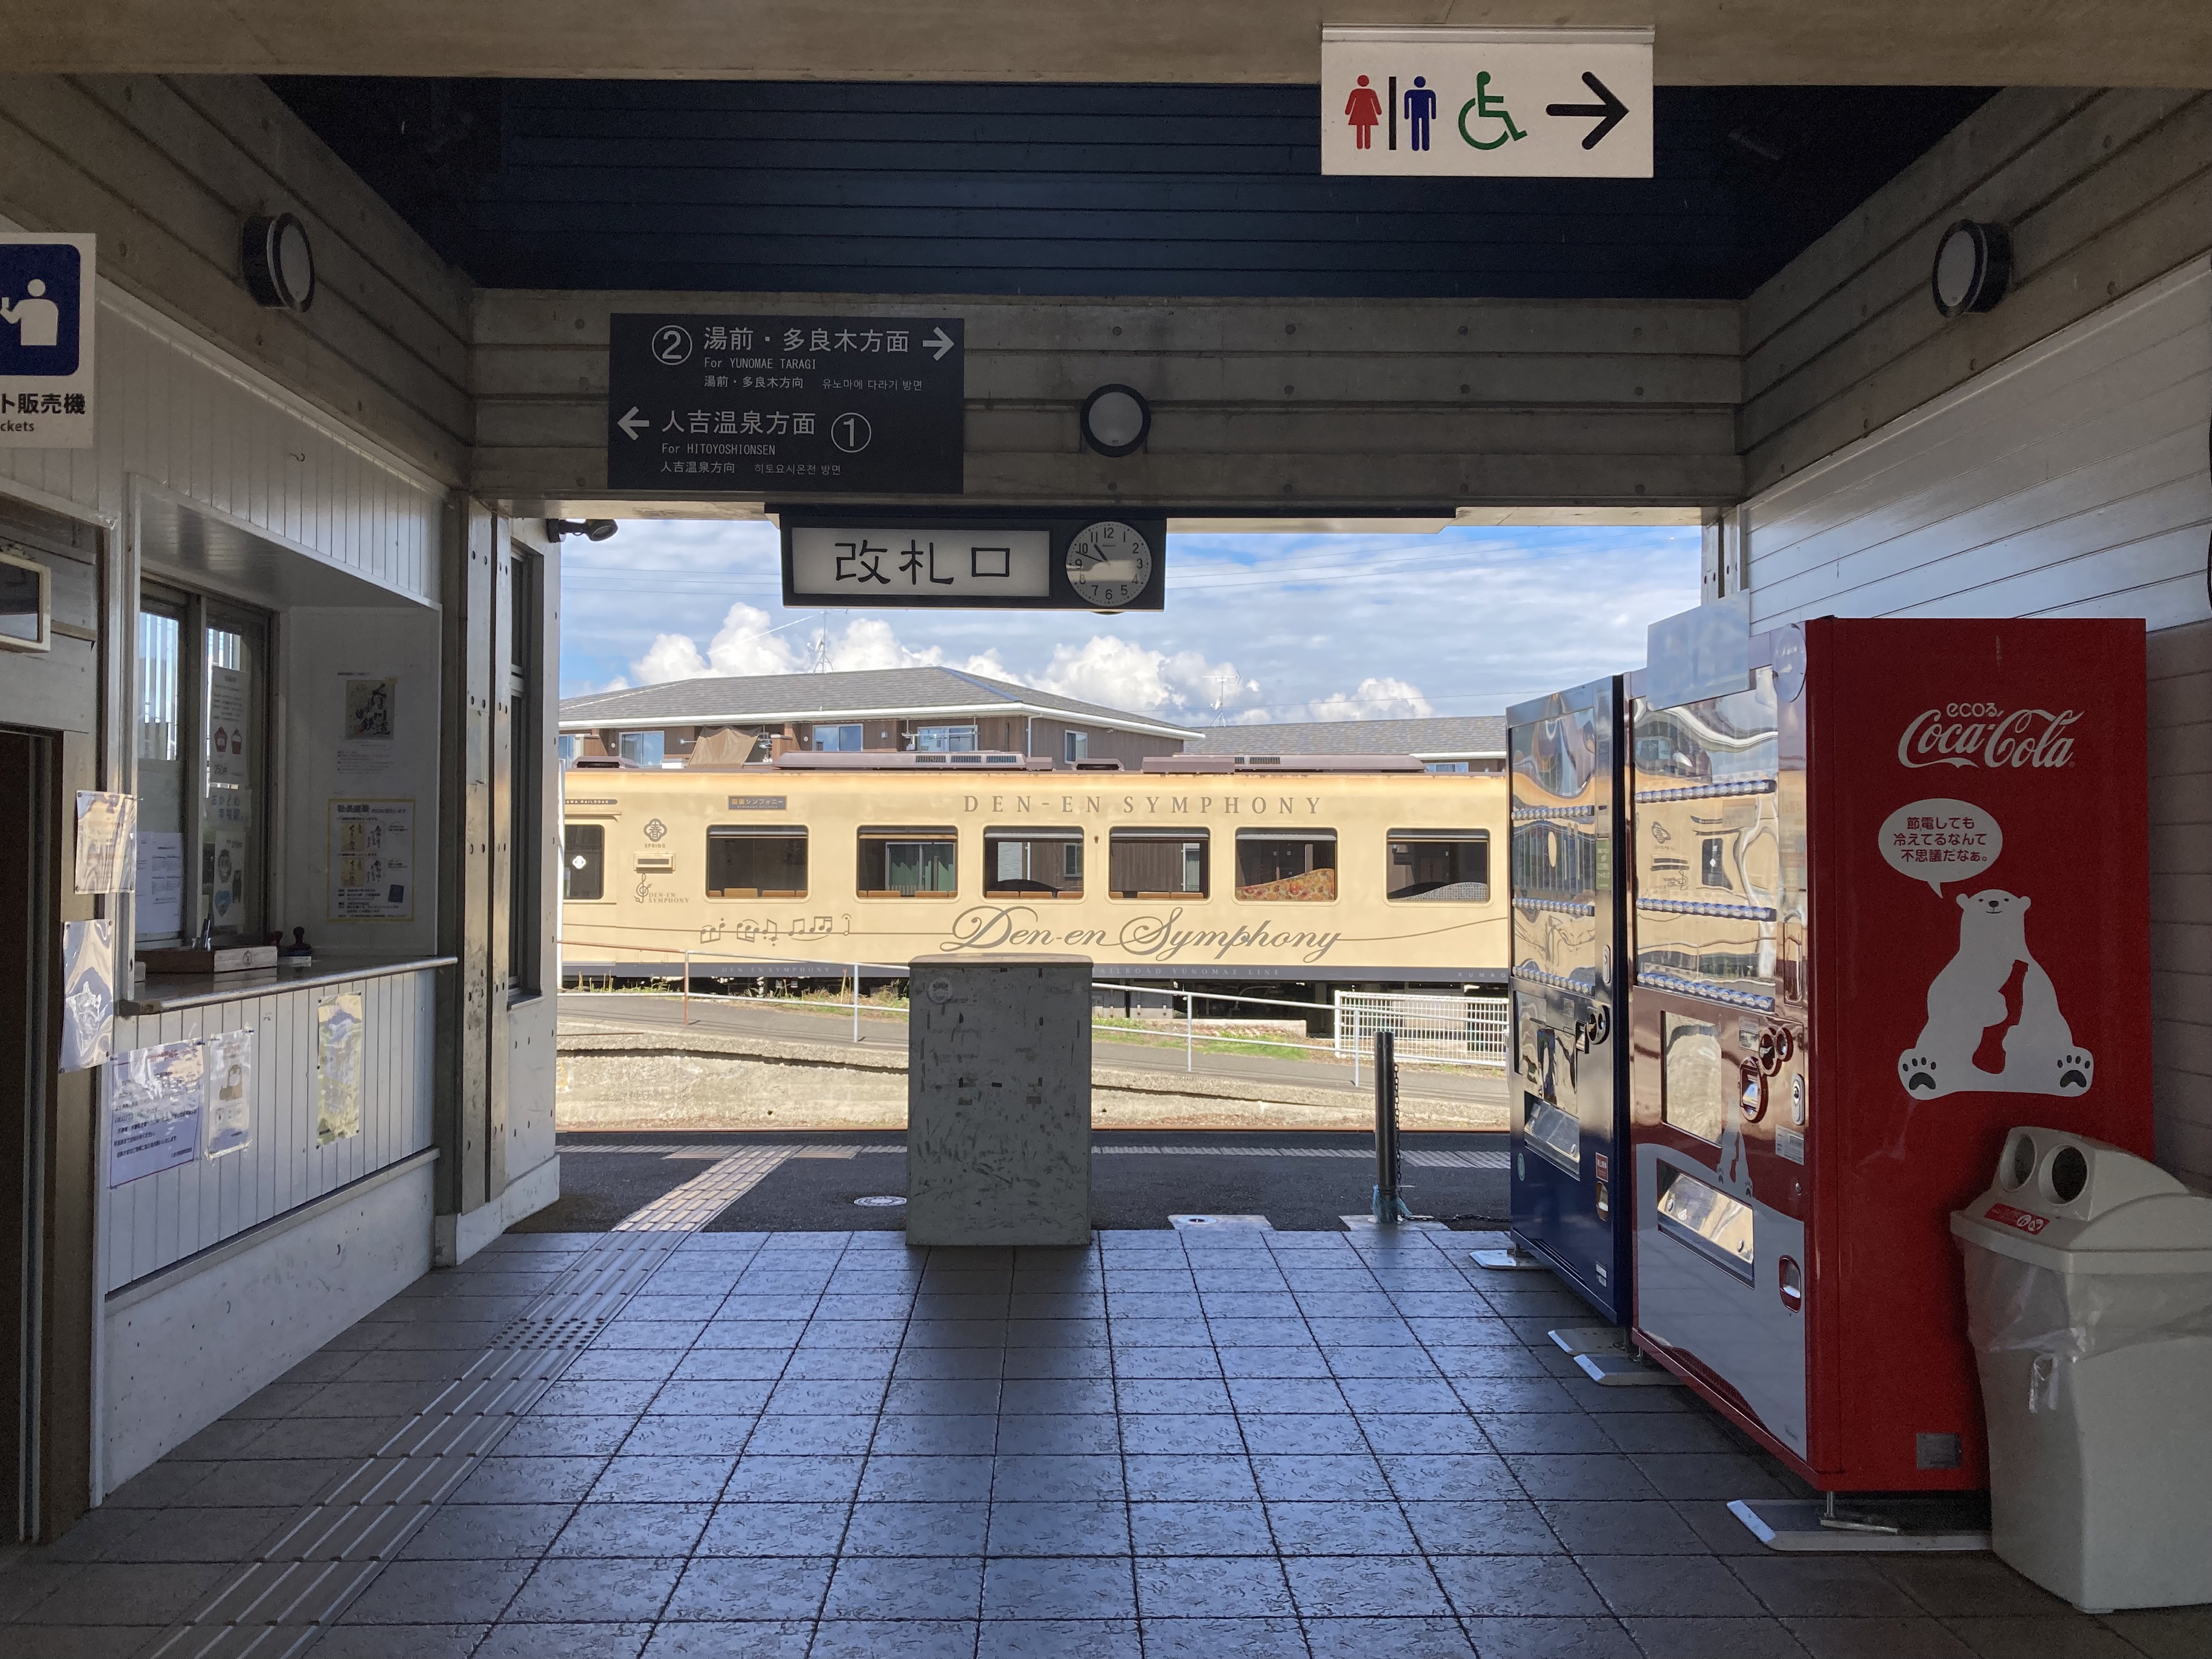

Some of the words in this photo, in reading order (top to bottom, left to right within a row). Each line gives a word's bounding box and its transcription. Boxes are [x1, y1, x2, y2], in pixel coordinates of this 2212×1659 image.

[703, 326, 909, 353] 湯前・多良木方面
[705, 357, 723, 368] For
[729, 358, 773, 369] YUNOMAE
[779, 359, 816, 370] TARAGI
[704, 375, 804, 389] 湯前・多良木方向
[822, 378, 863, 391] 유노마에
[868, 379, 898, 391] 다라기
[902, 379, 923, 391] 방면
[2, 393, 85, 414] ト販売機
[0, 420, 35, 431] ckets
[662, 410, 816, 436] 人吉温泉方面
[662, 444, 680, 454] For
[687, 444, 776, 456] HITOYOSHIONSEN
[661, 461, 736, 474] 人吉温泉方向
[754, 462, 816, 476] 히토요시온천
[821, 464, 842, 476] 방면
[1091, 531, 1098, 543] 11
[1104, 527, 1114, 539] 12
[1078, 543, 1088, 554] 10
[1132, 543, 1139, 554] 2
[834, 539, 1011, 585] 改札口
[1075, 559, 1082, 570] 9
[1137, 558, 1143, 569] 3
[1091, 585, 1098, 596] 7
[1106, 589, 1112, 600] 6
[1121, 585, 1128, 596] 5
[1898, 708, 2085, 768] Coca-Cola
[963, 794, 1101, 813] DEN-EN
[1123, 796, 1324, 815] SYMPHONY
[1907, 817, 1975, 830] 節電しても
[649, 823, 662, 838] 春
[1893, 833, 1987, 846] 冷えてるなんて
[940, 905, 1110, 952] Den-en
[1119, 907, 1341, 962] Symphony
